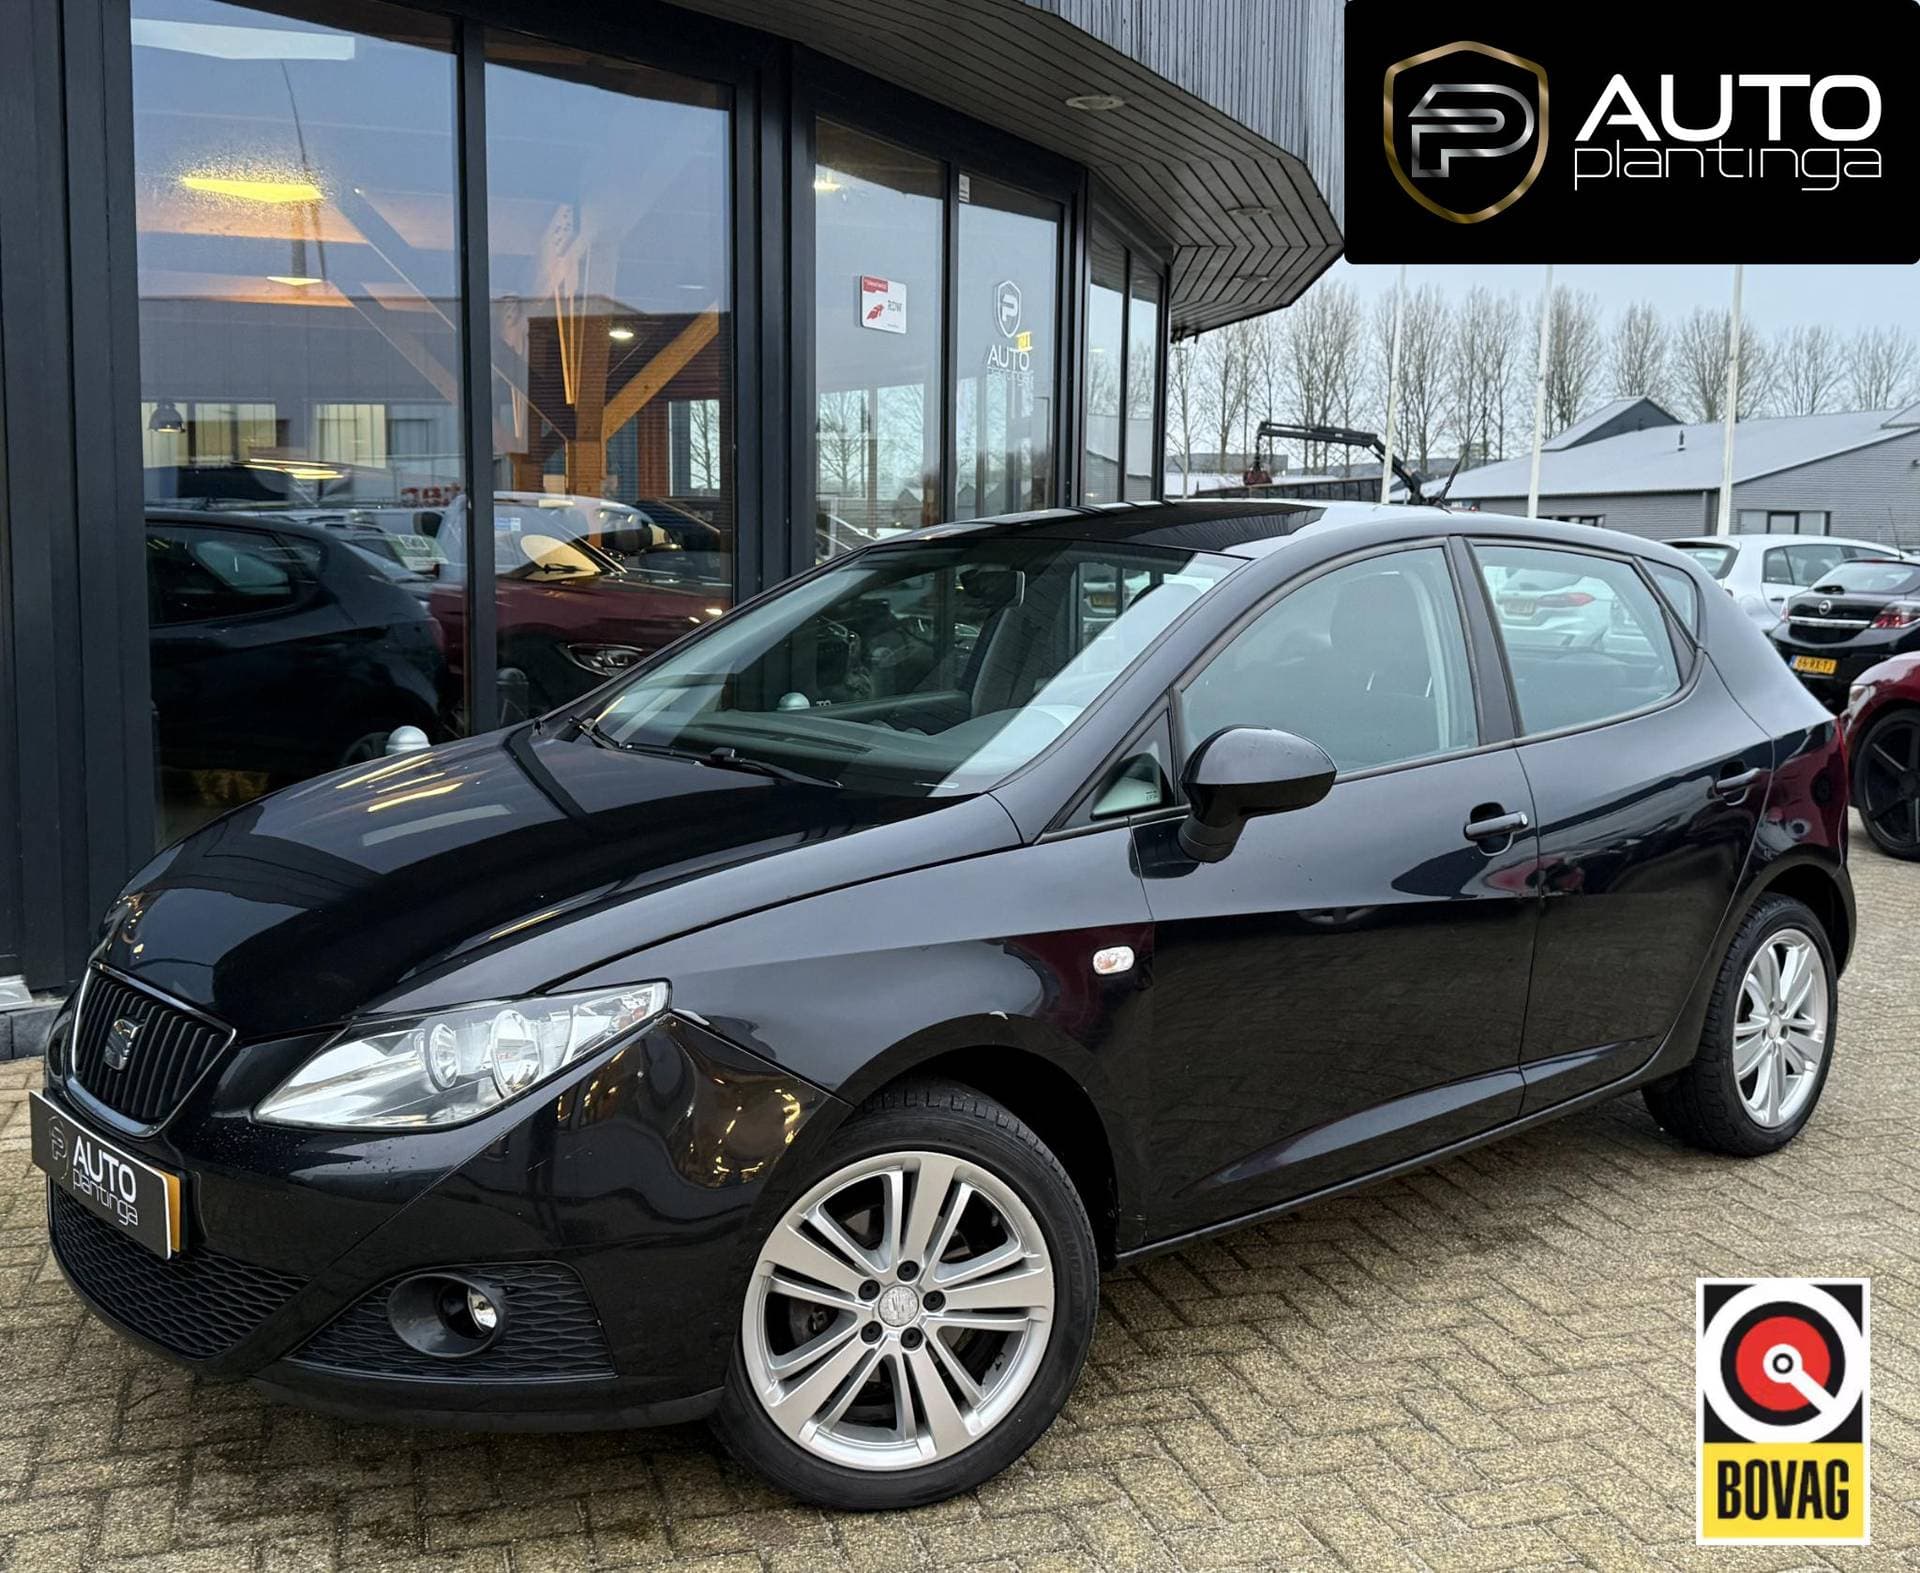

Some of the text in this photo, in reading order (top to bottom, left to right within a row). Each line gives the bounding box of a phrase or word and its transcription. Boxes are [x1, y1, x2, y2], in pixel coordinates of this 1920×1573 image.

[987, 344, 1030, 371] AUTO
[73, 1135, 137, 1204] AUTO
[73, 1168, 139, 1226] plantinga
